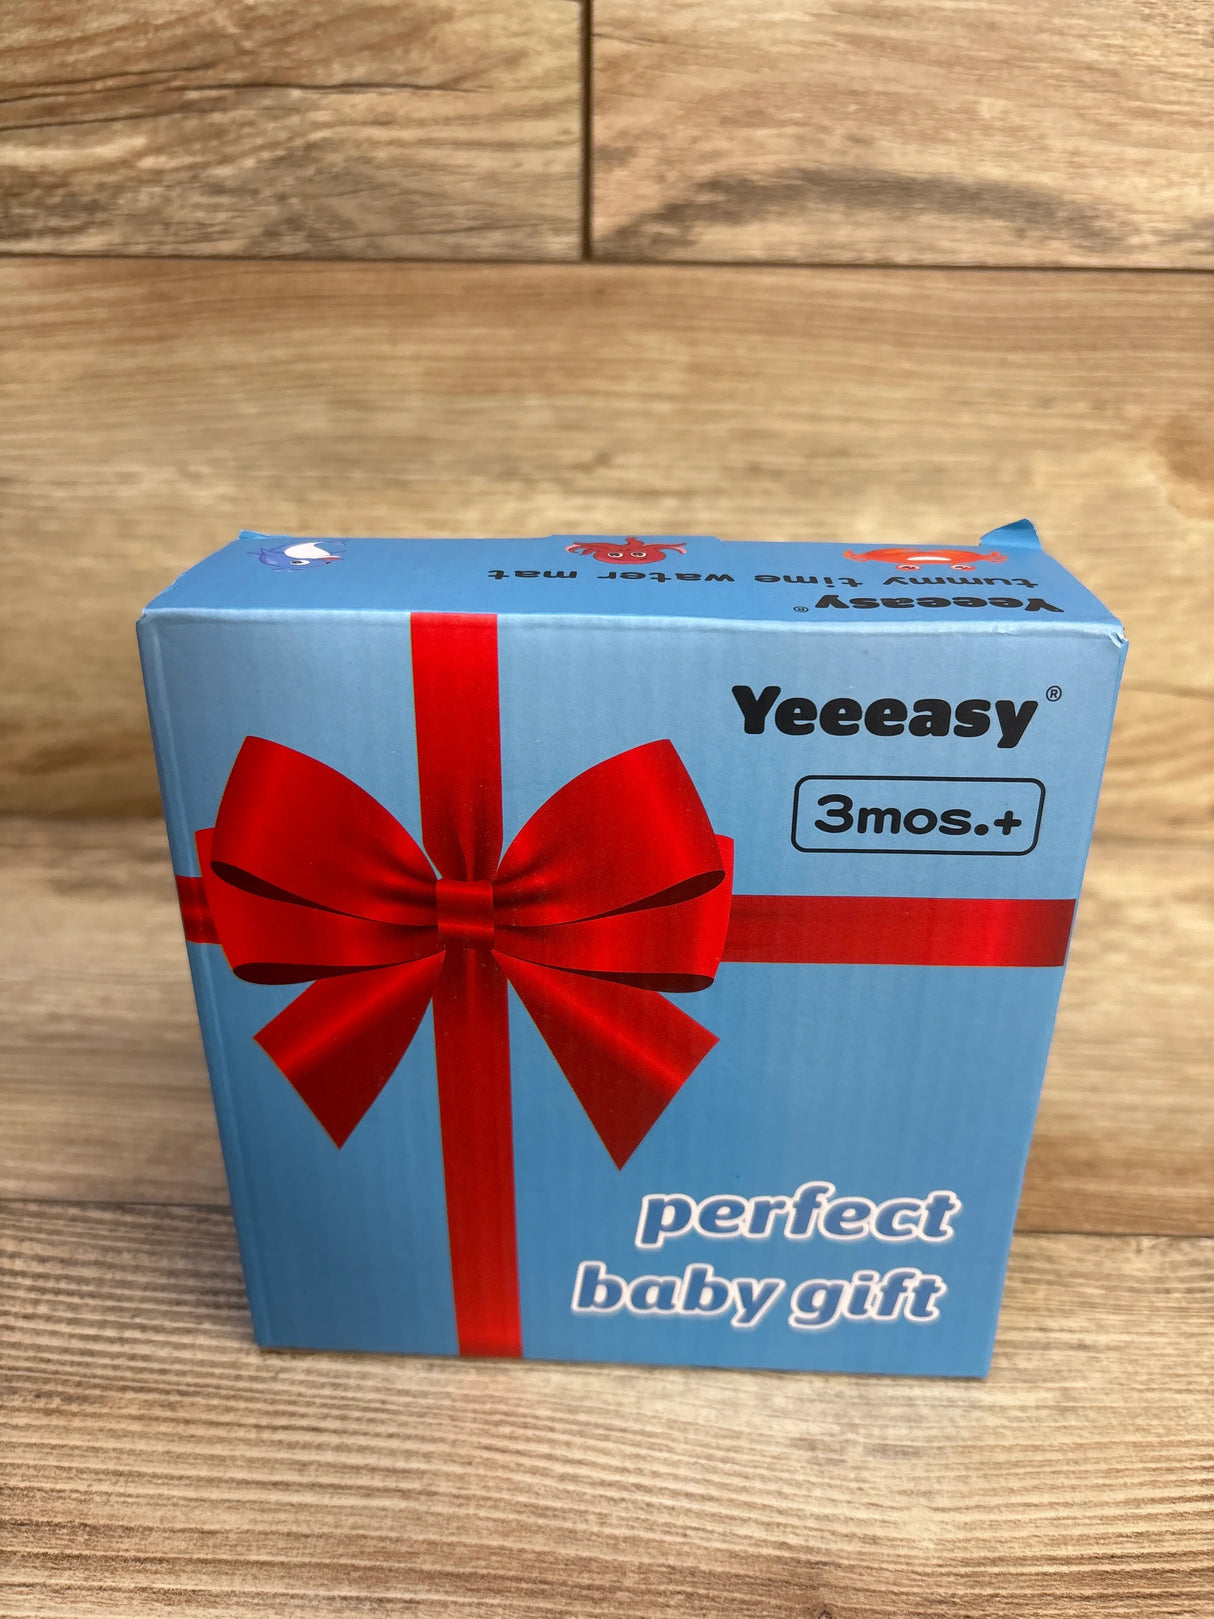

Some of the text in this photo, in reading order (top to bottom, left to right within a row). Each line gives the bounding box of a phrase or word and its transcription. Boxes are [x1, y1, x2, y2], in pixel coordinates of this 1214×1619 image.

[488, 570, 1039, 588] tummy time water mat
[814, 793, 1022, 836] 3mos.+
[635, 1181, 962, 1248] perfect
[572, 1261, 947, 1329] baby gift
